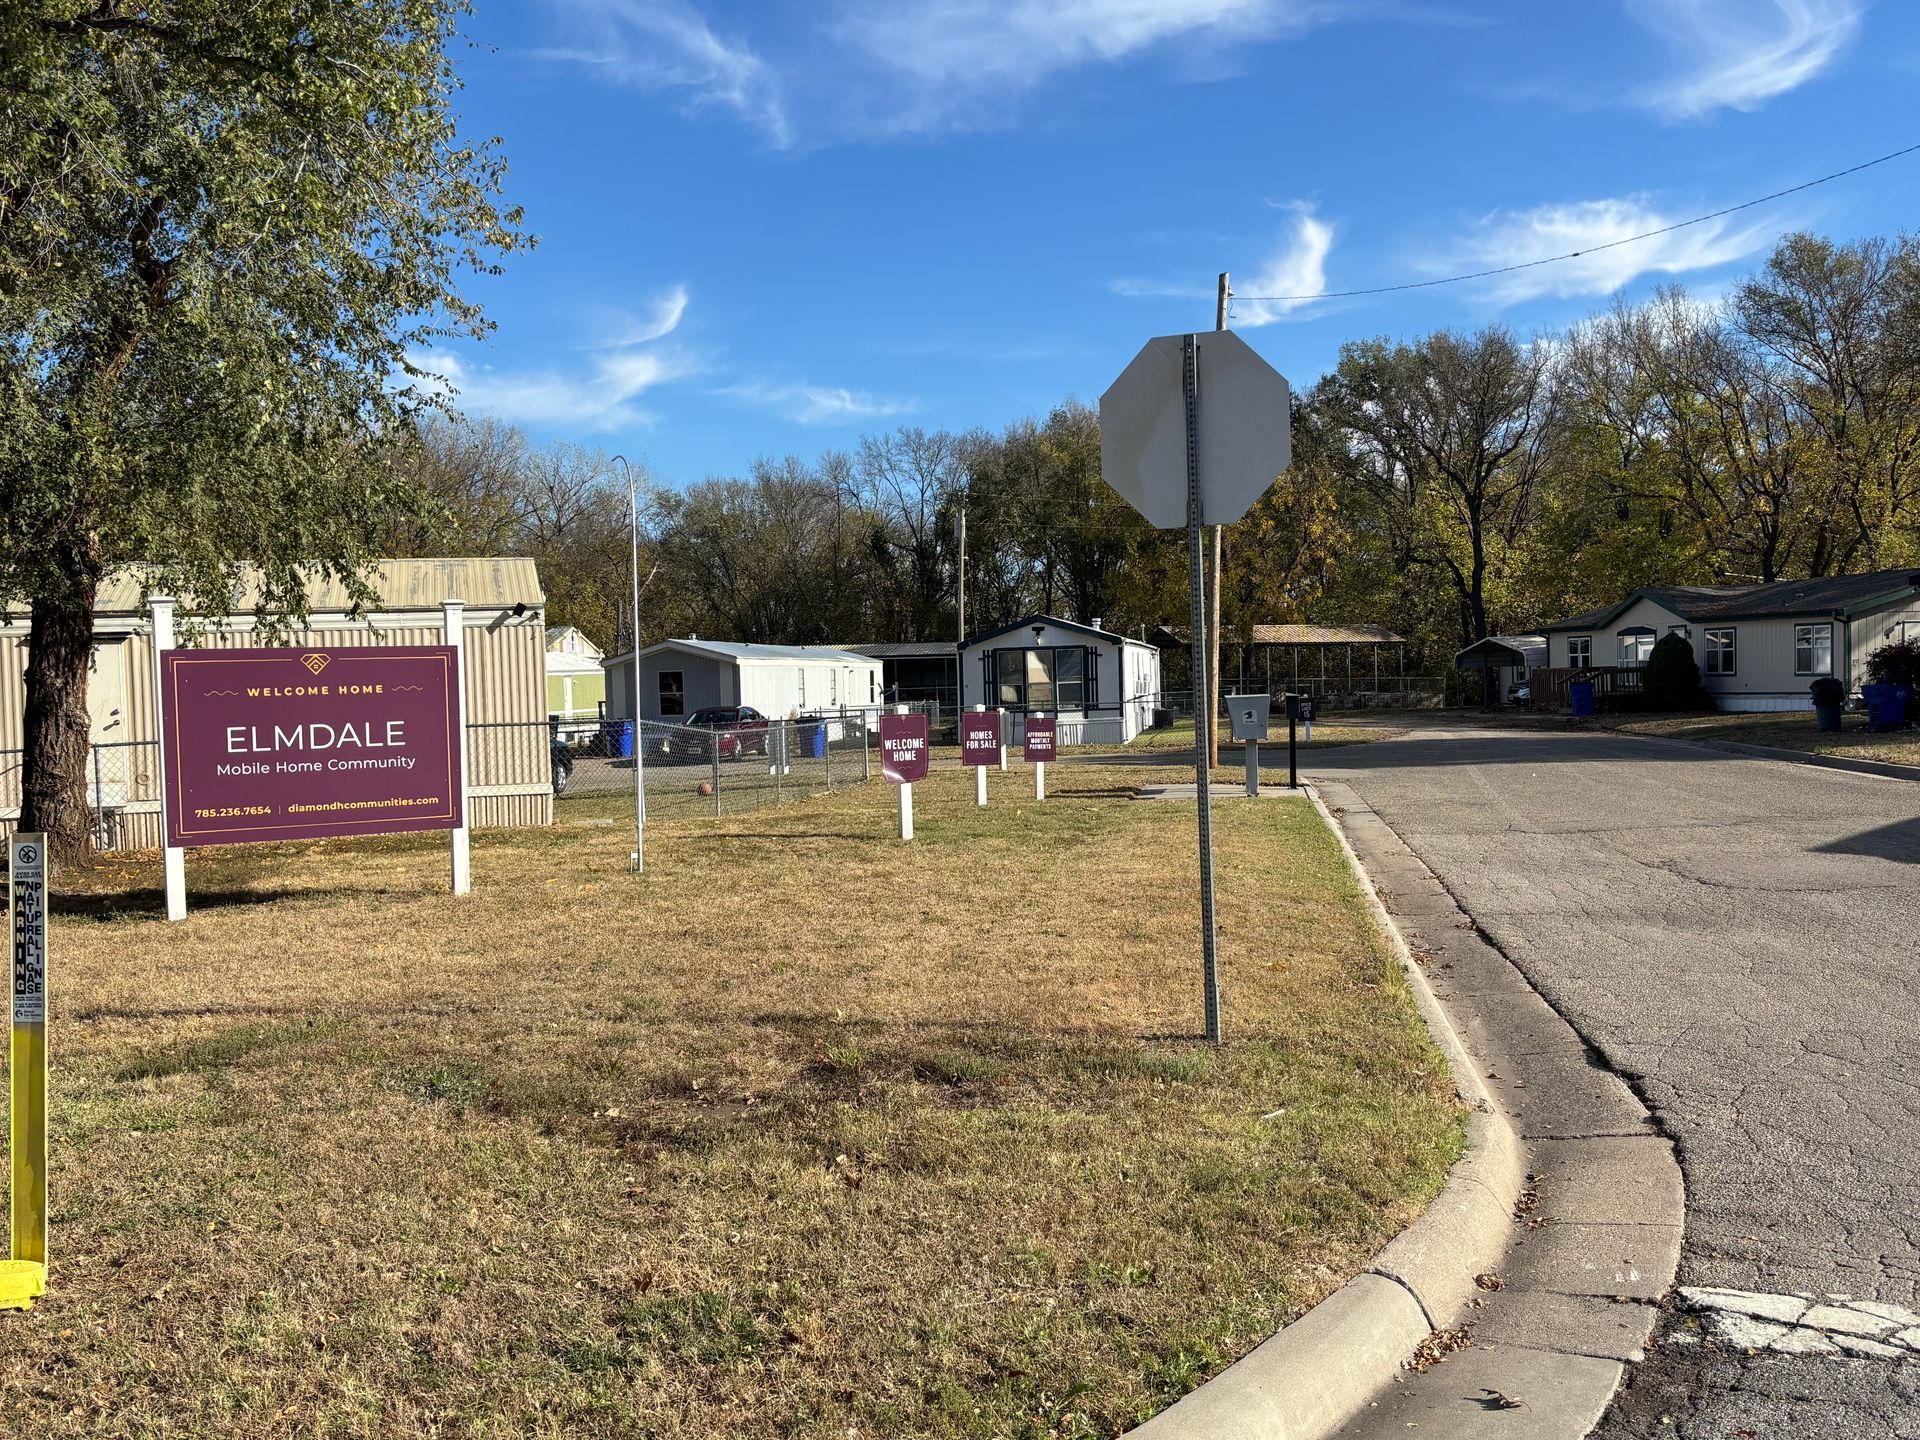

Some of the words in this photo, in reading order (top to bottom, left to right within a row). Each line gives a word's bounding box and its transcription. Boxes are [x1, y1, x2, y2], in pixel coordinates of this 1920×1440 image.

[247, 686, 330, 698] WELCOME
[338, 684, 384, 695] HOME
[226, 720, 406, 753] ELMDALE
[884, 738, 924, 750] WELCOME
[966, 740, 979, 749] FOR
[980, 740, 997, 748] SALE
[970, 730, 993, 740] HOMES
[216, 762, 270, 776] Mobile
[276, 760, 323, 774] Home
[328, 756, 416, 772] Community
[893, 750, 916, 762] HOME
[195, 805, 272, 818] 785.236.7654
[288, 796, 439, 814] diamondhcommunities.com
[26, 881, 34, 957] NATURAL
[15, 884, 25, 991] WARNING
[26, 962, 34, 994] GAS
